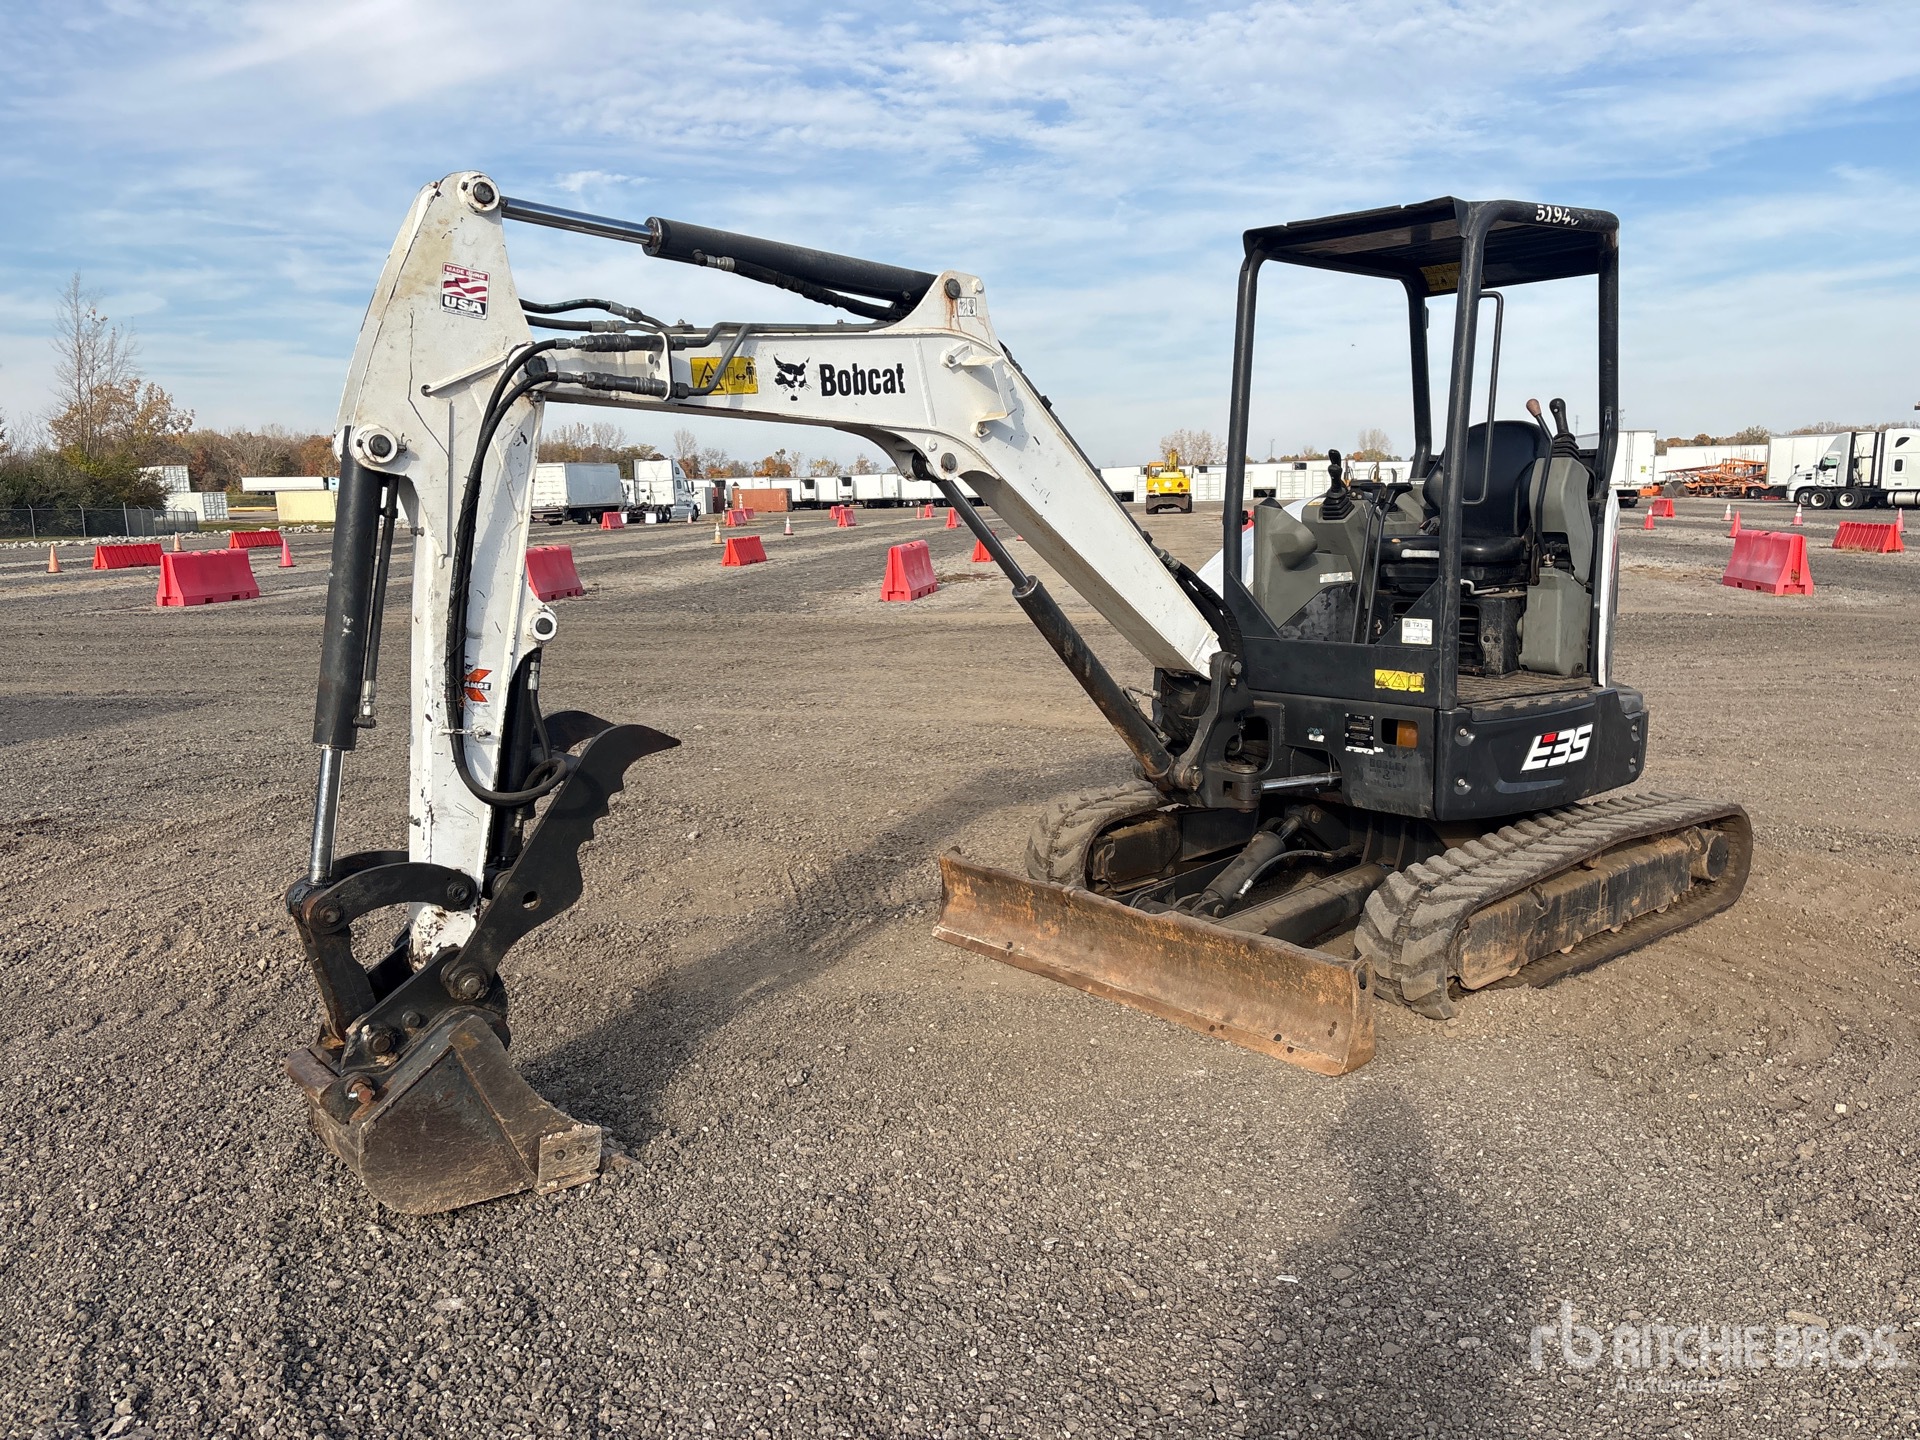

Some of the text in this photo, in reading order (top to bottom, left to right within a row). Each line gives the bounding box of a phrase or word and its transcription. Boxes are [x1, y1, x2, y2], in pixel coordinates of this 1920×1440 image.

[446, 266, 466, 275] MADE
[444, 295, 484, 314] USA
[819, 363, 906, 397] Bobcat
[1521, 723, 1593, 771] E35
